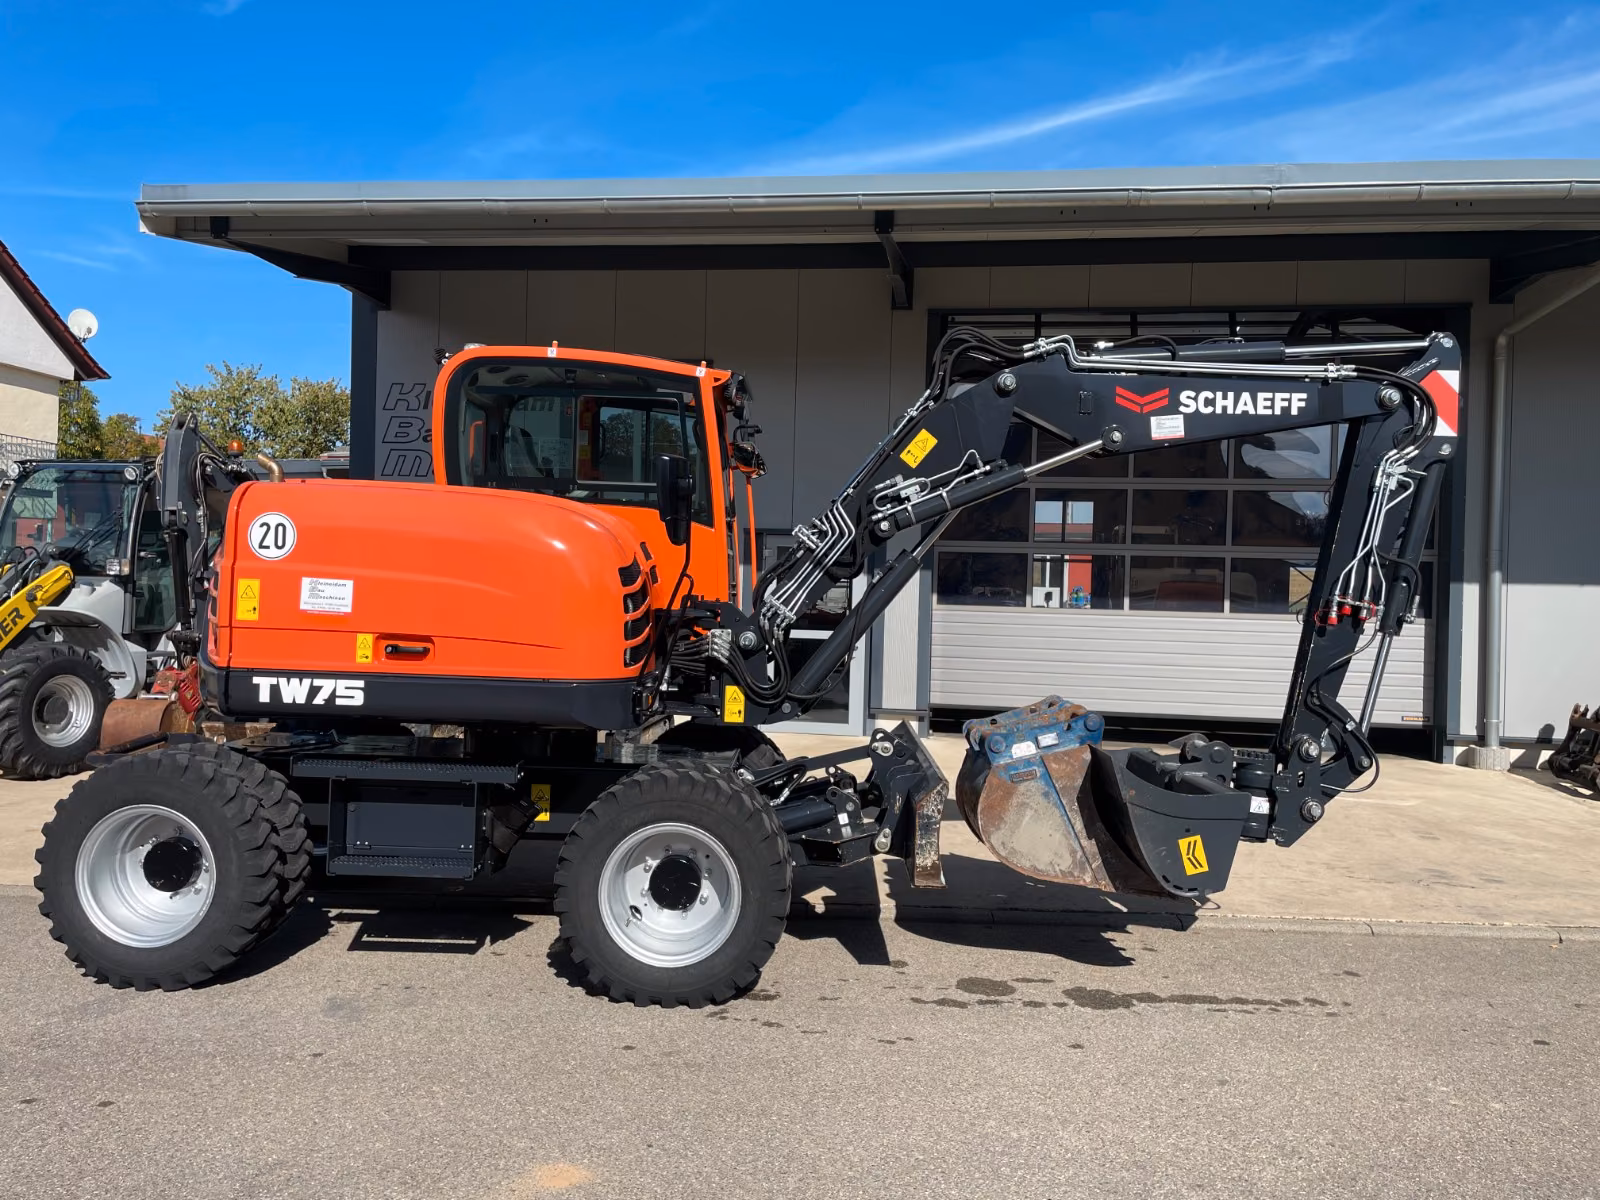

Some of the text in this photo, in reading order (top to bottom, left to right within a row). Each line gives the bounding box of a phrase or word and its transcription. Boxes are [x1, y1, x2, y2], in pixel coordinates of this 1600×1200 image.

[1178, 390, 1307, 415] SCHAEFF
[382, 416, 433, 443] Ba
[258, 522, 287, 550] 20
[252, 676, 364, 706] TW75
